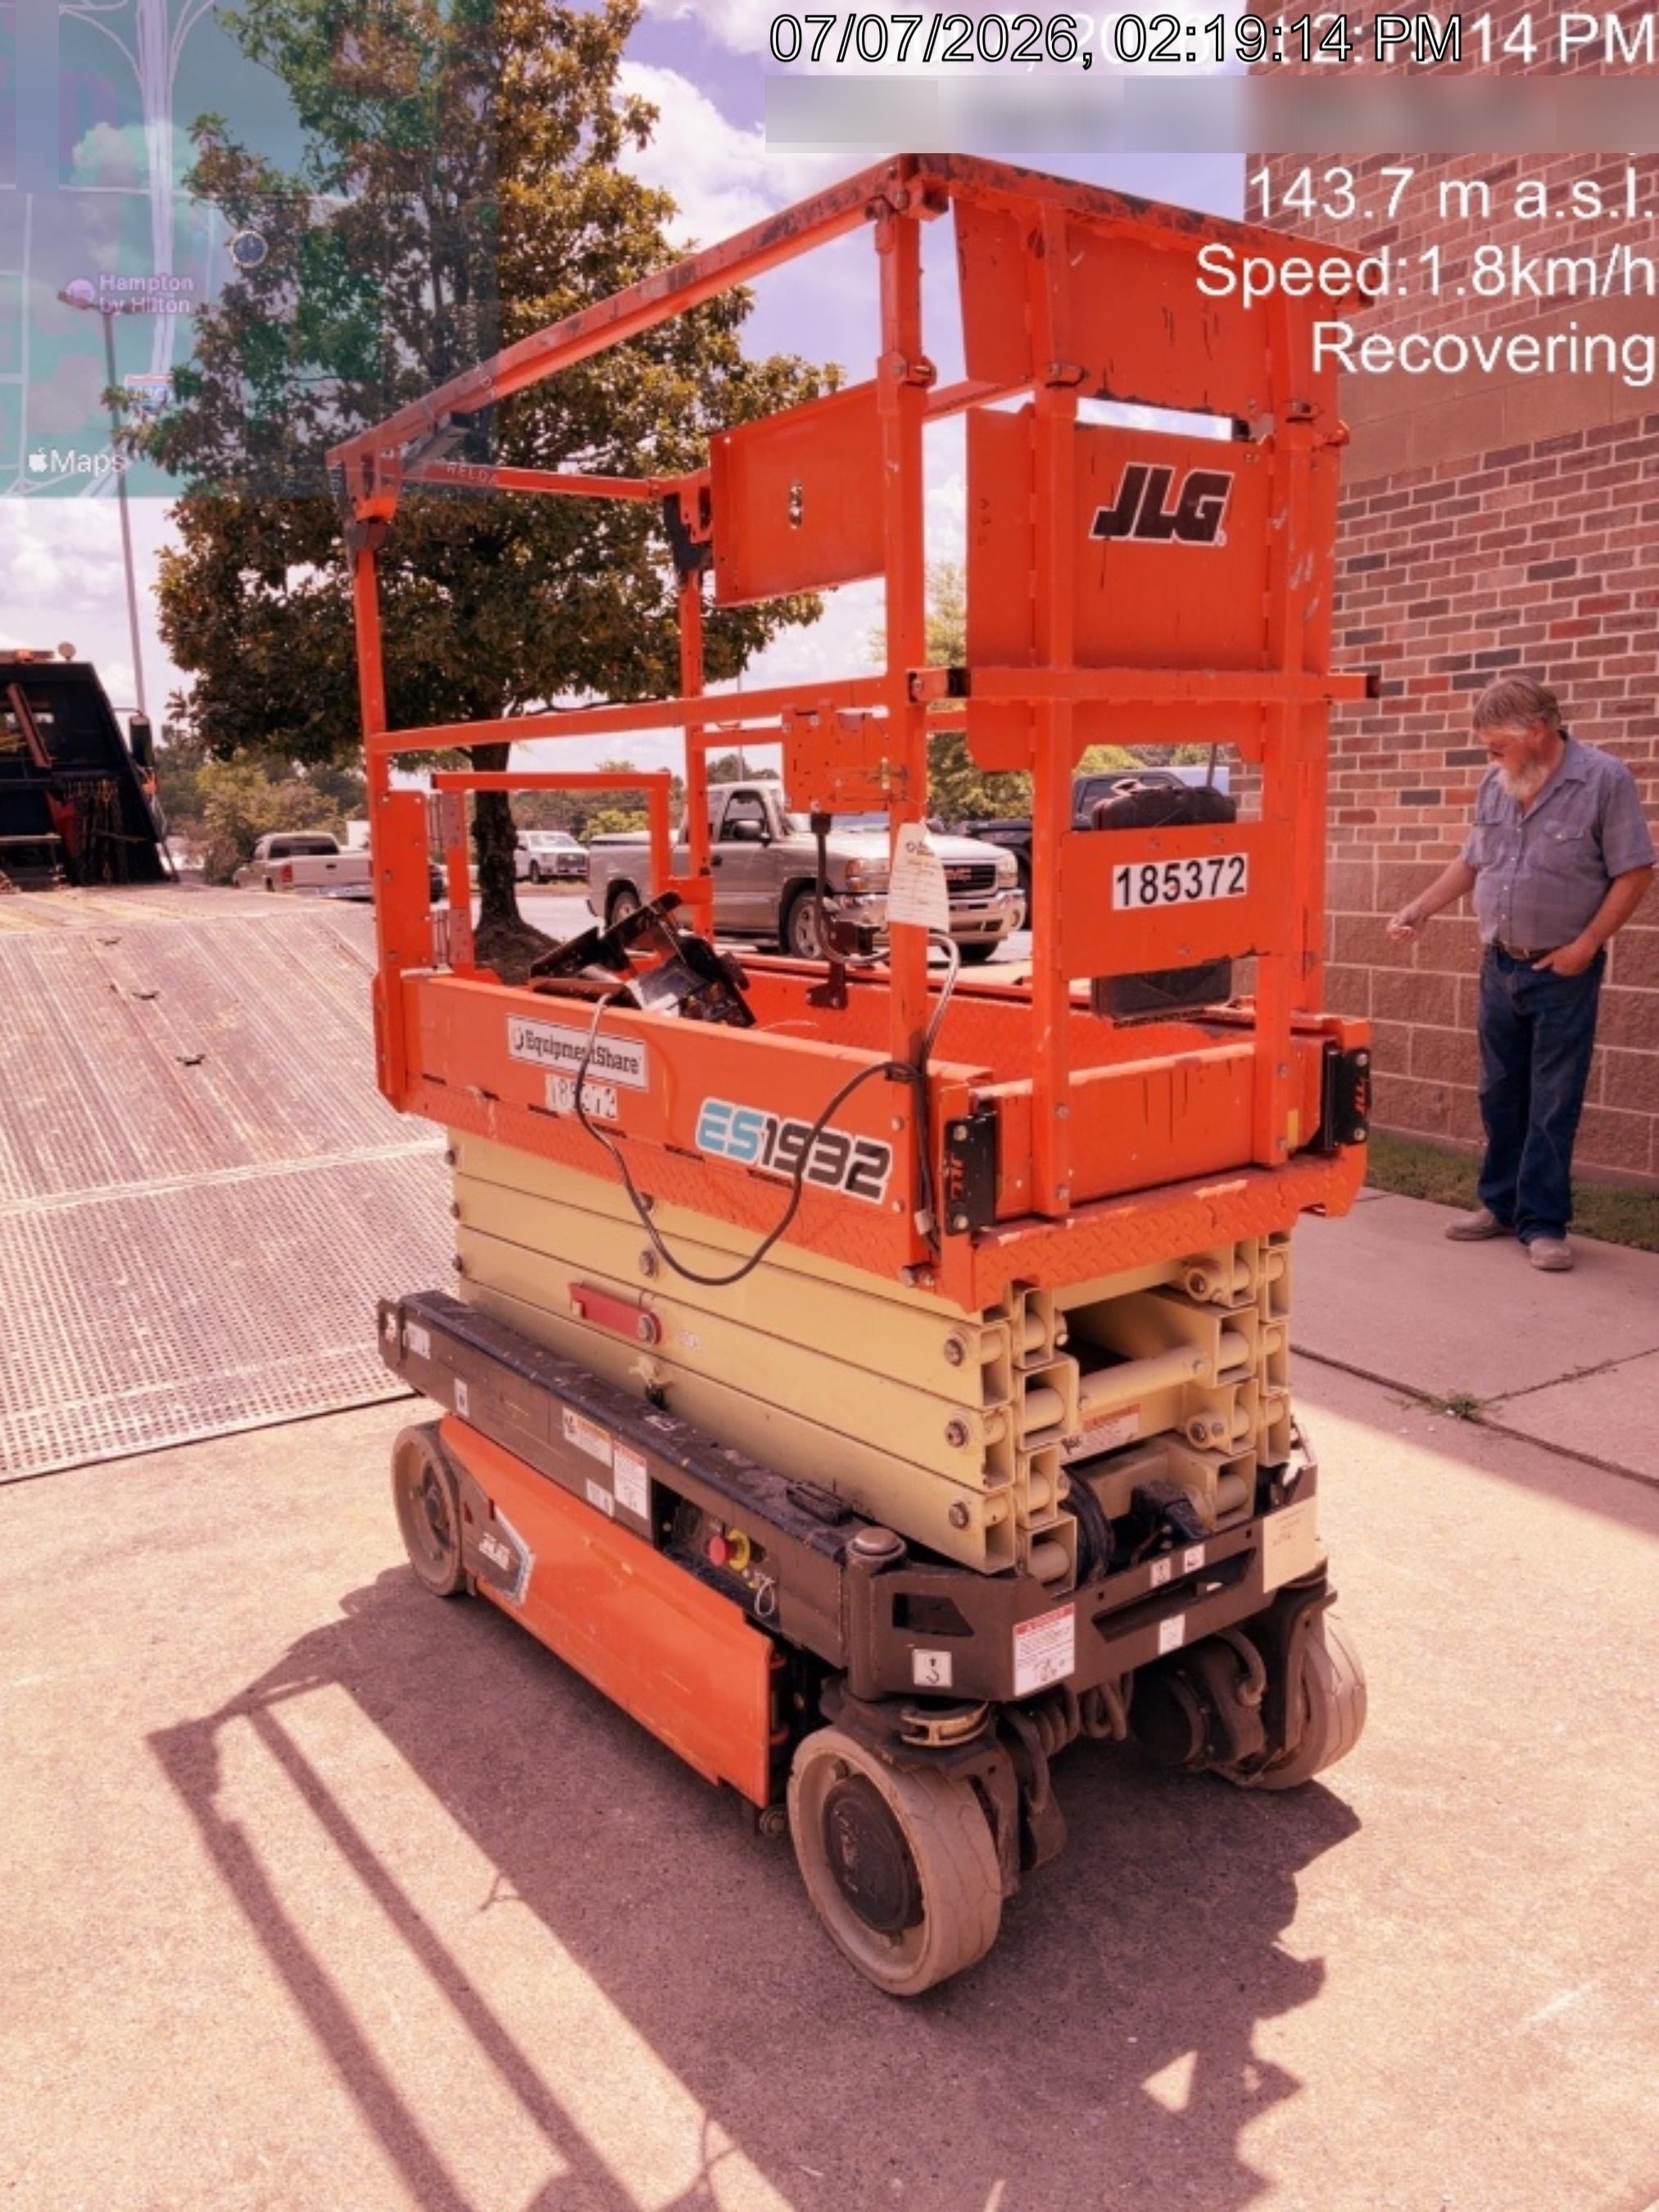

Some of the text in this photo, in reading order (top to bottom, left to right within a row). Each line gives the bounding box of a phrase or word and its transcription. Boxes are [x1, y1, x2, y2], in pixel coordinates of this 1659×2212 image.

[1090, 462, 1234, 547] JLG
[1117, 856, 1244, 907] 185372
[697, 1098, 892, 1204] ES1932
